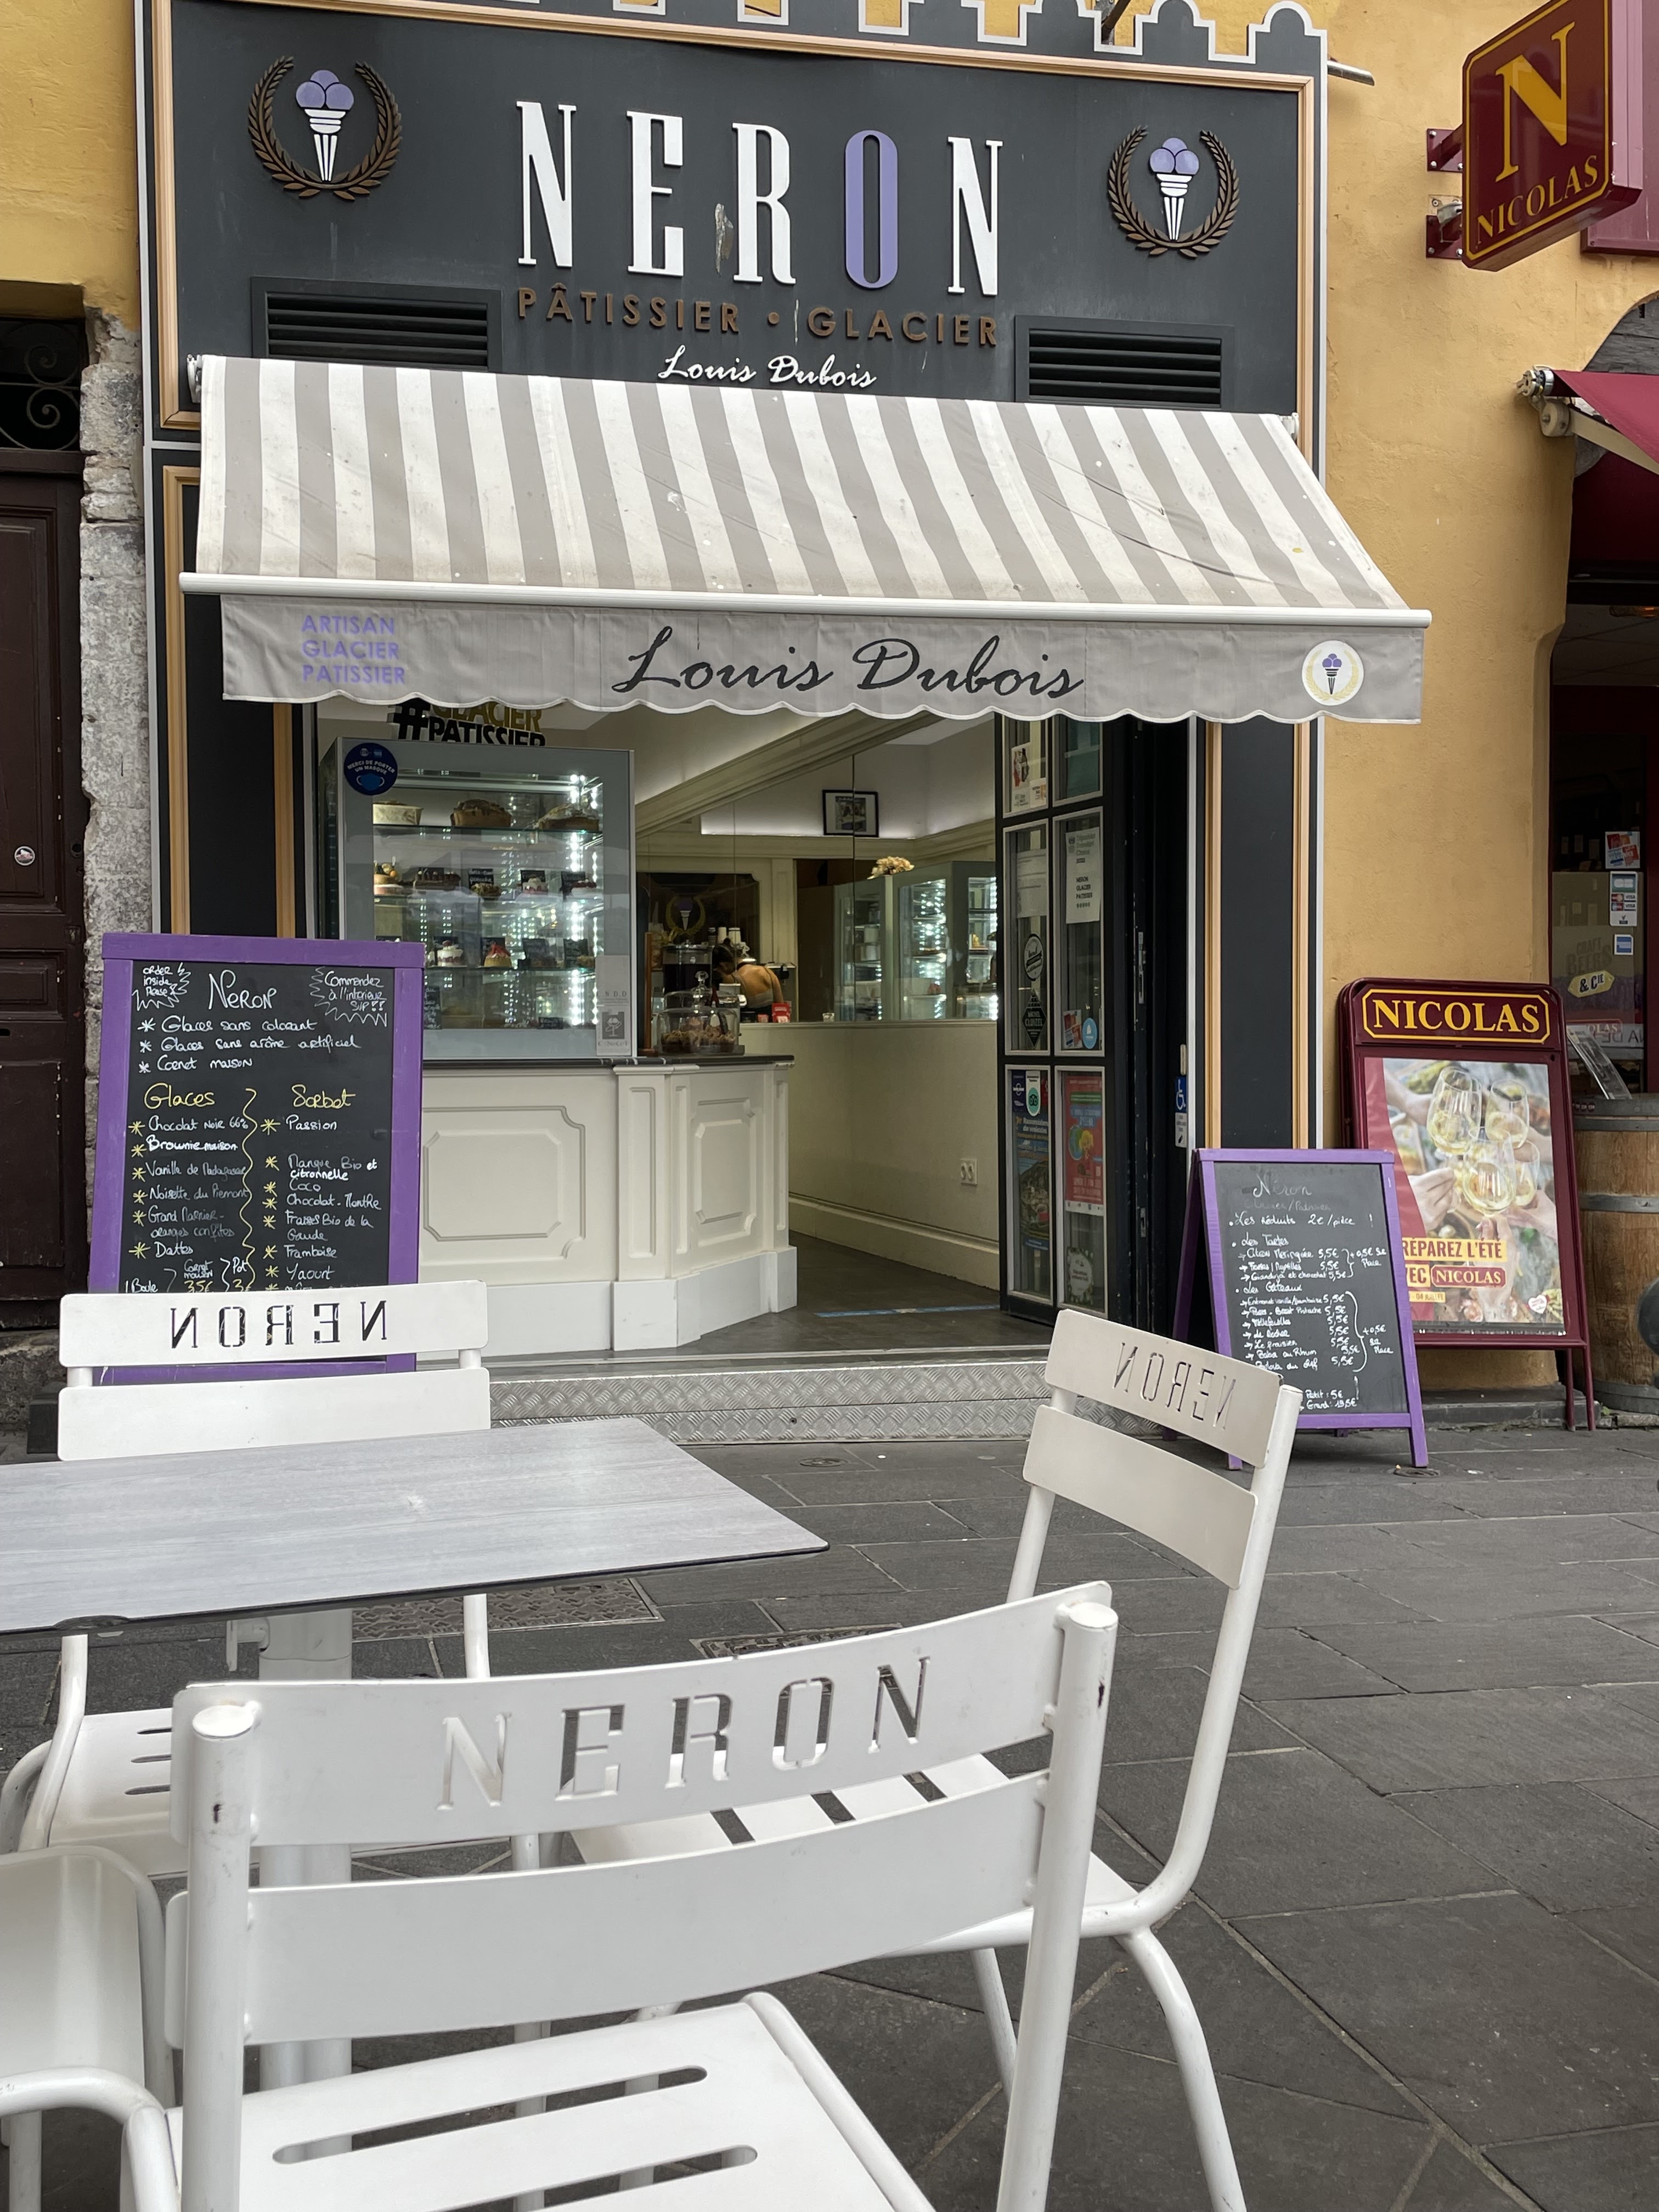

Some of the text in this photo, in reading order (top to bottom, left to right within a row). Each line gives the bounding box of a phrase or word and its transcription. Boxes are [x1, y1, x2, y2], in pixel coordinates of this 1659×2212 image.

[1496, 21, 1576, 182] N
[516, 100, 1003, 296] NERON
[1477, 155, 1598, 245] NICOLAS
[518, 283, 996, 346] PÂTISSIER GLACIER
[658, 345, 877, 390] Louis Dubois
[301, 615, 394, 636] ARTISAN
[302, 640, 399, 661] GLACIER
[612, 626, 1084, 698] Louis Dubois
[302, 665, 405, 685] PATISSIER
[347, 760, 364, 770] MERCI
[375, 761, 395, 774] PORTER
[364, 765, 387, 775] MASQUE
[324, 970, 384, 988] Commandez
[161, 1015, 318, 1034] Glaces sans colorant
[1372, 999, 1540, 1034] NICOLAS
[161, 1039, 204, 1052] Glaces
[144, 1082, 216, 1110] Glaces
[291, 1084, 357, 1109] Sorbet
[148, 1116, 199, 1132] Chocolat
[285, 1115, 338, 1131] Passion
[187, 1160, 199, 1175] de
[340, 1156, 362, 1170] Bio
[366, 1158, 377, 1170] et
[290, 1168, 349, 1182] citronnelle
[194, 1186, 209, 1199] du
[289, 1178, 321, 1192] Coco
[286, 1194, 334, 1206] Chocolat
[148, 1207, 178, 1223] Grand
[321, 1213, 341, 1227] Bio
[344, 1214, 357, 1227] de
[359, 1214, 374, 1228] la
[1262, 1233, 1289, 1247] Tartes
[154, 1242, 194, 1257] Dattes
[284, 1245, 337, 1259] Framboise
[1402, 1238, 1502, 1259] RÉPAREZ L'ÉTÉ
[233, 1257, 249, 1274] Pot
[1436, 1270, 1502, 1284] NICOLAS
[132, 1278, 159, 1293] Boule
[436, 1656, 931, 1811] NERON
